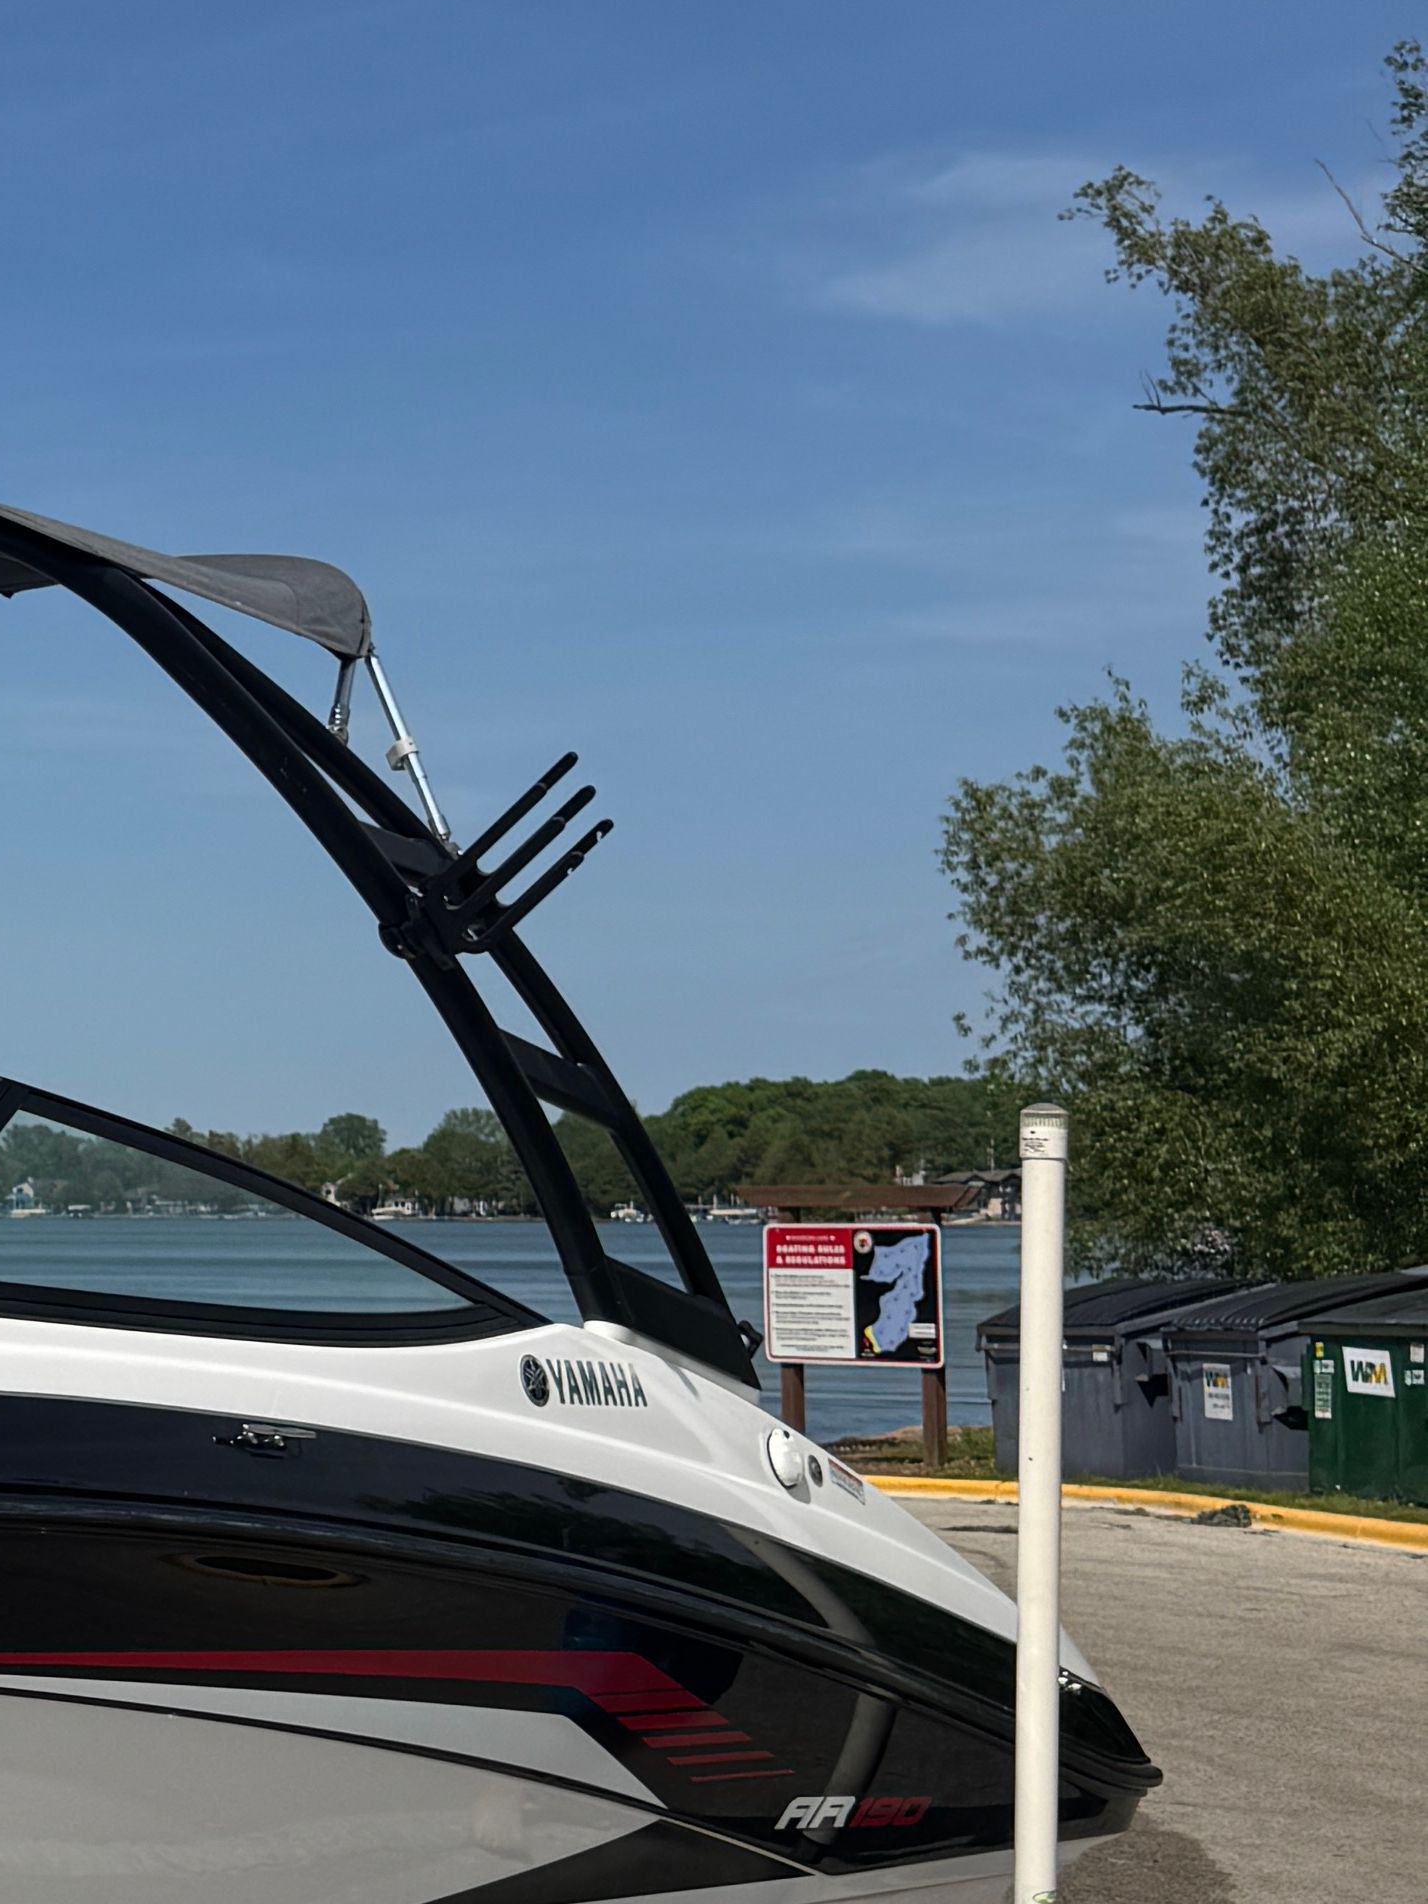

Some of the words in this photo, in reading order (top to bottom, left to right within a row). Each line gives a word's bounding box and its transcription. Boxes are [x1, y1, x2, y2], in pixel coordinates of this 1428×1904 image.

[785, 1255, 846, 1265] REGULATIONS
[545, 1358, 648, 1407] YAMAHA
[1350, 1359, 1389, 1386] WM
